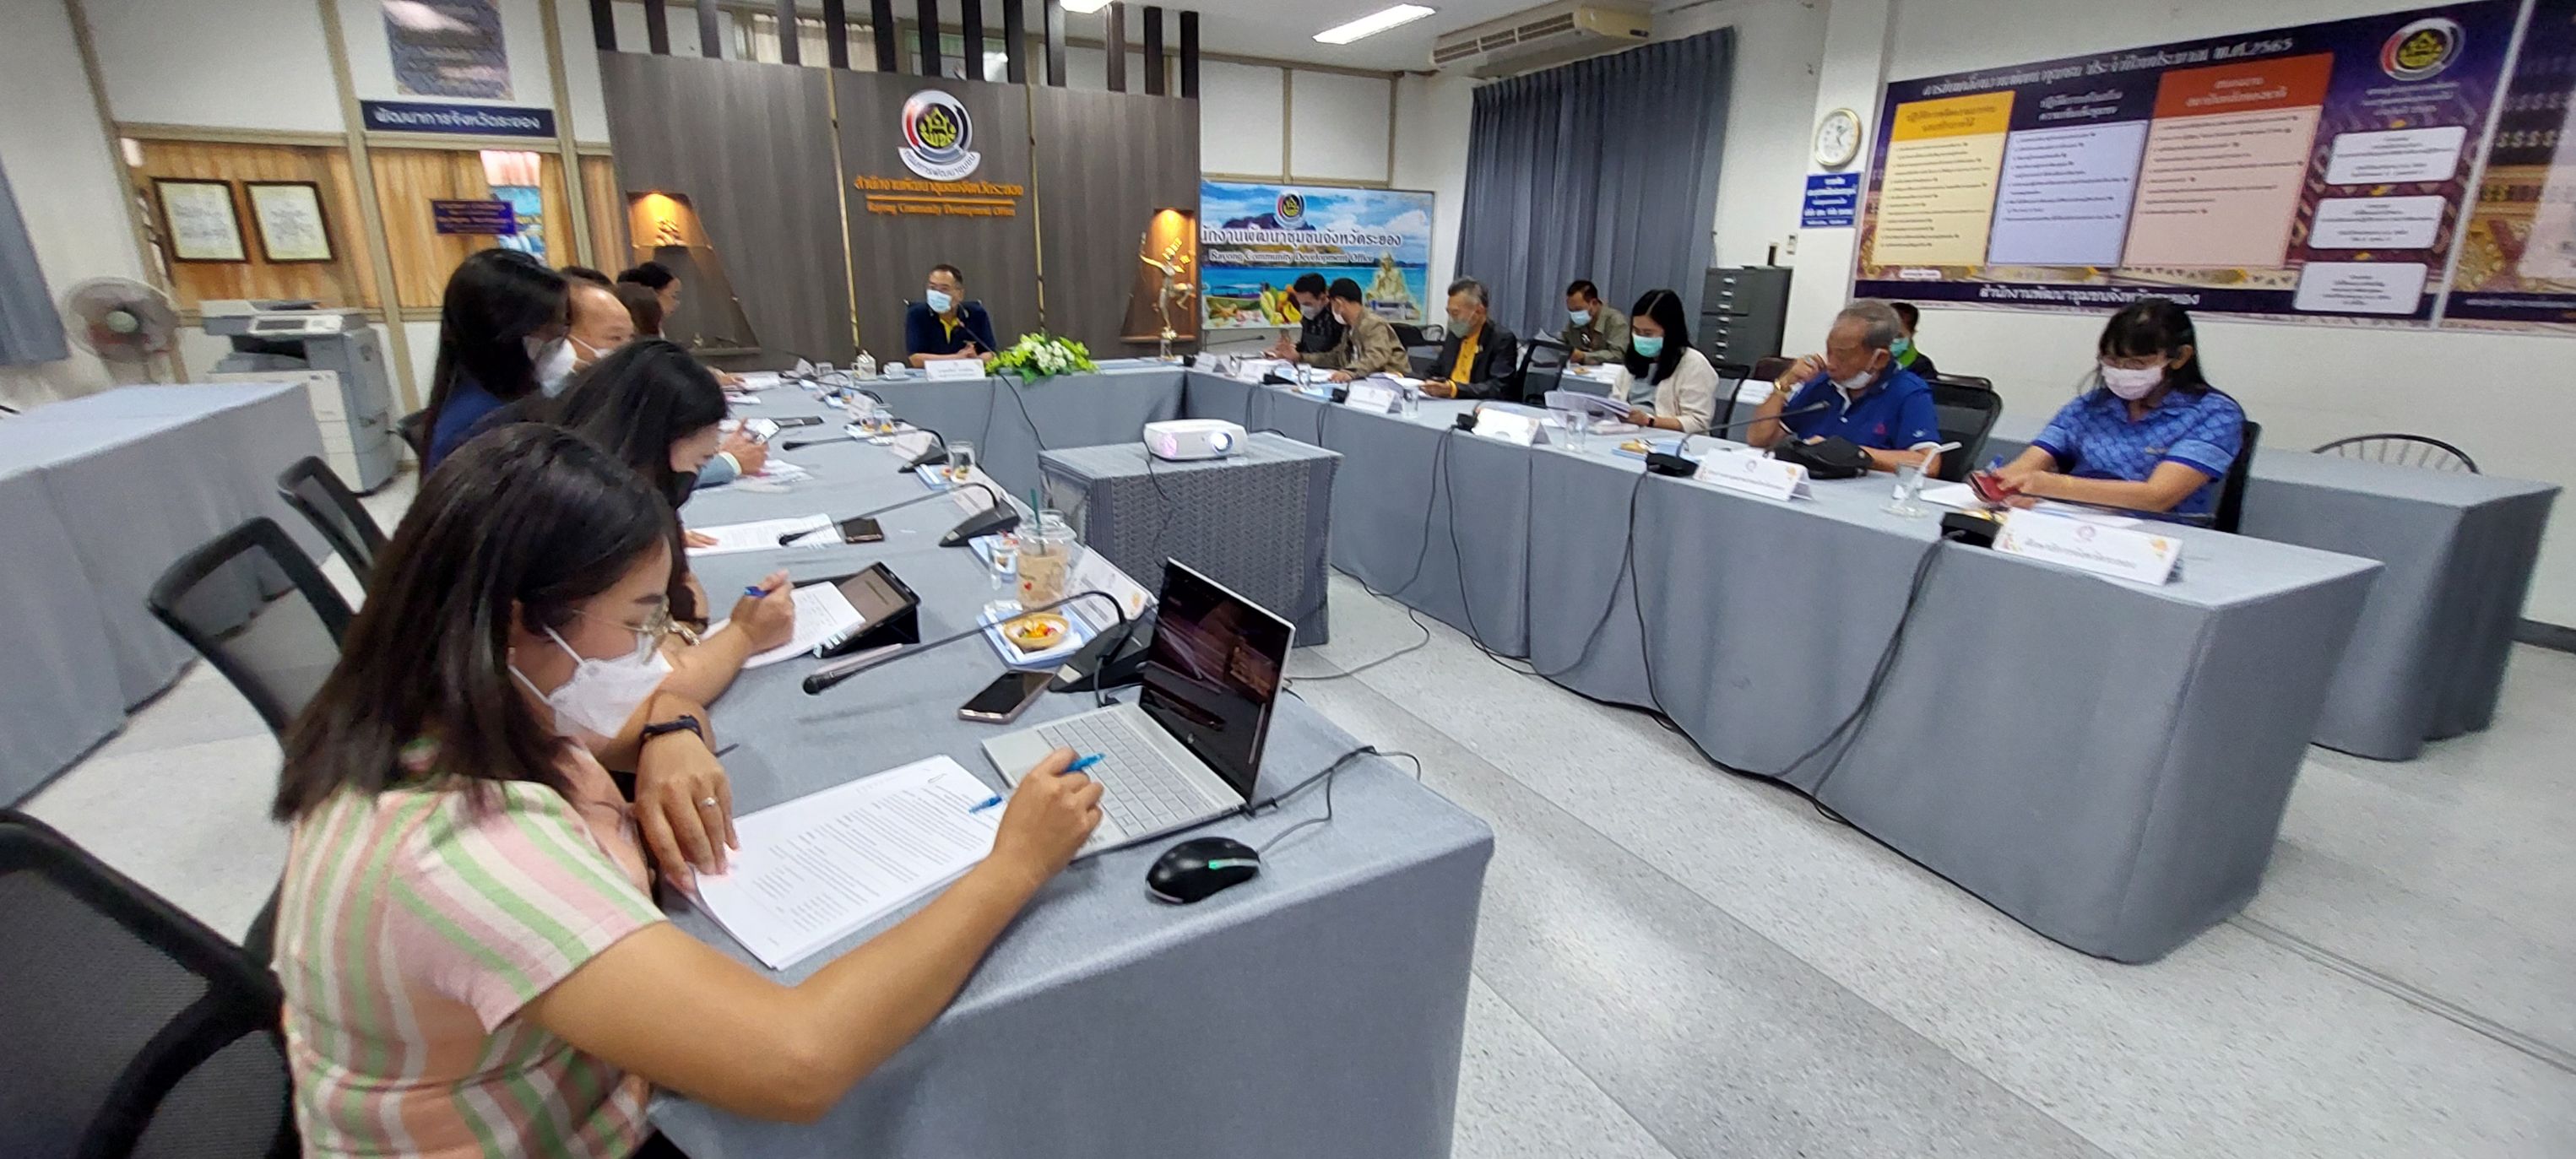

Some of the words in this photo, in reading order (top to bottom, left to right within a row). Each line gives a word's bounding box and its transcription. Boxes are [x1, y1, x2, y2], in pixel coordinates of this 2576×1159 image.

[1210, 251, 1245, 263] Rayong
[1245, 251, 1293, 263] Community
[1295, 252, 1349, 264] Development
[1350, 254, 1375, 263] Office
